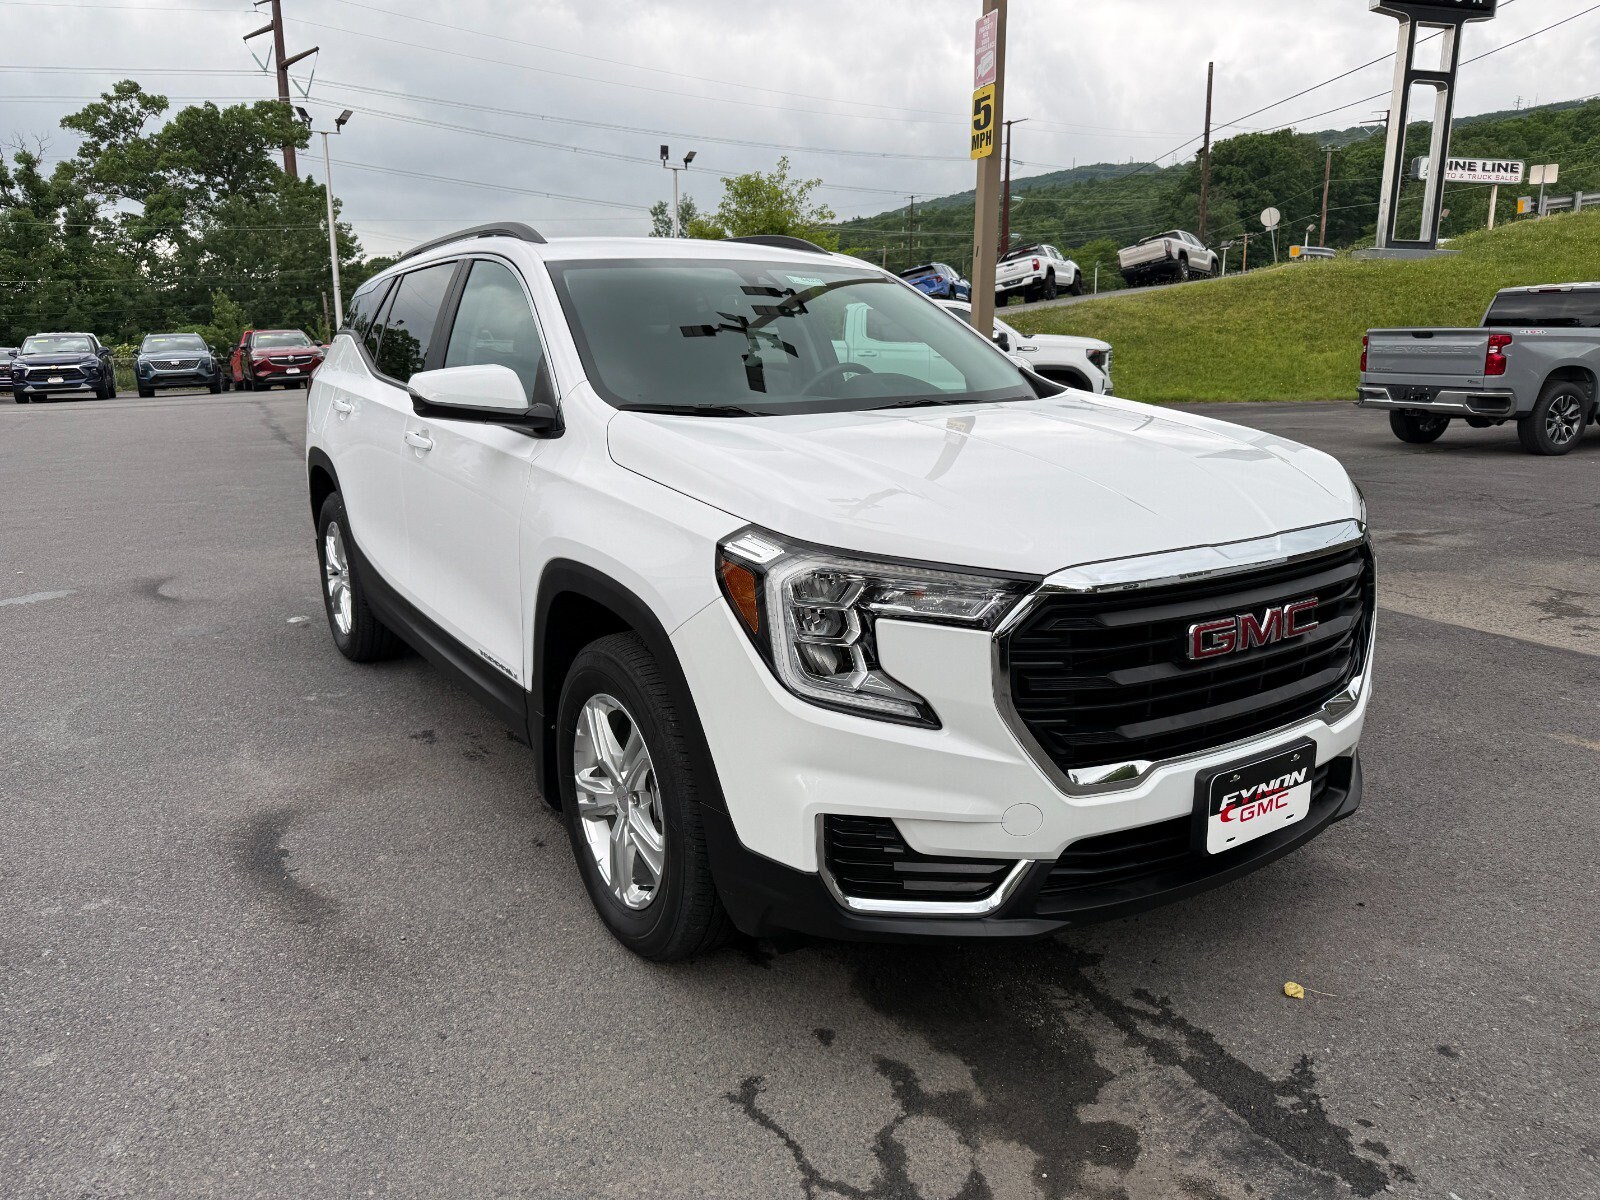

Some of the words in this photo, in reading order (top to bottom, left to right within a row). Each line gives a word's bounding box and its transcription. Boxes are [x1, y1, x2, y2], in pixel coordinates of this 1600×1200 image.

[974, 94, 991, 130] 5
[972, 130, 992, 151] MPH
[1446, 160, 1477, 171] INE
[1482, 162, 1520, 173] LINE
[1373, 346, 1478, 354] CHEVROLET
[1188, 597, 1319, 660] GMC
[1240, 792, 1289, 822] GMC
